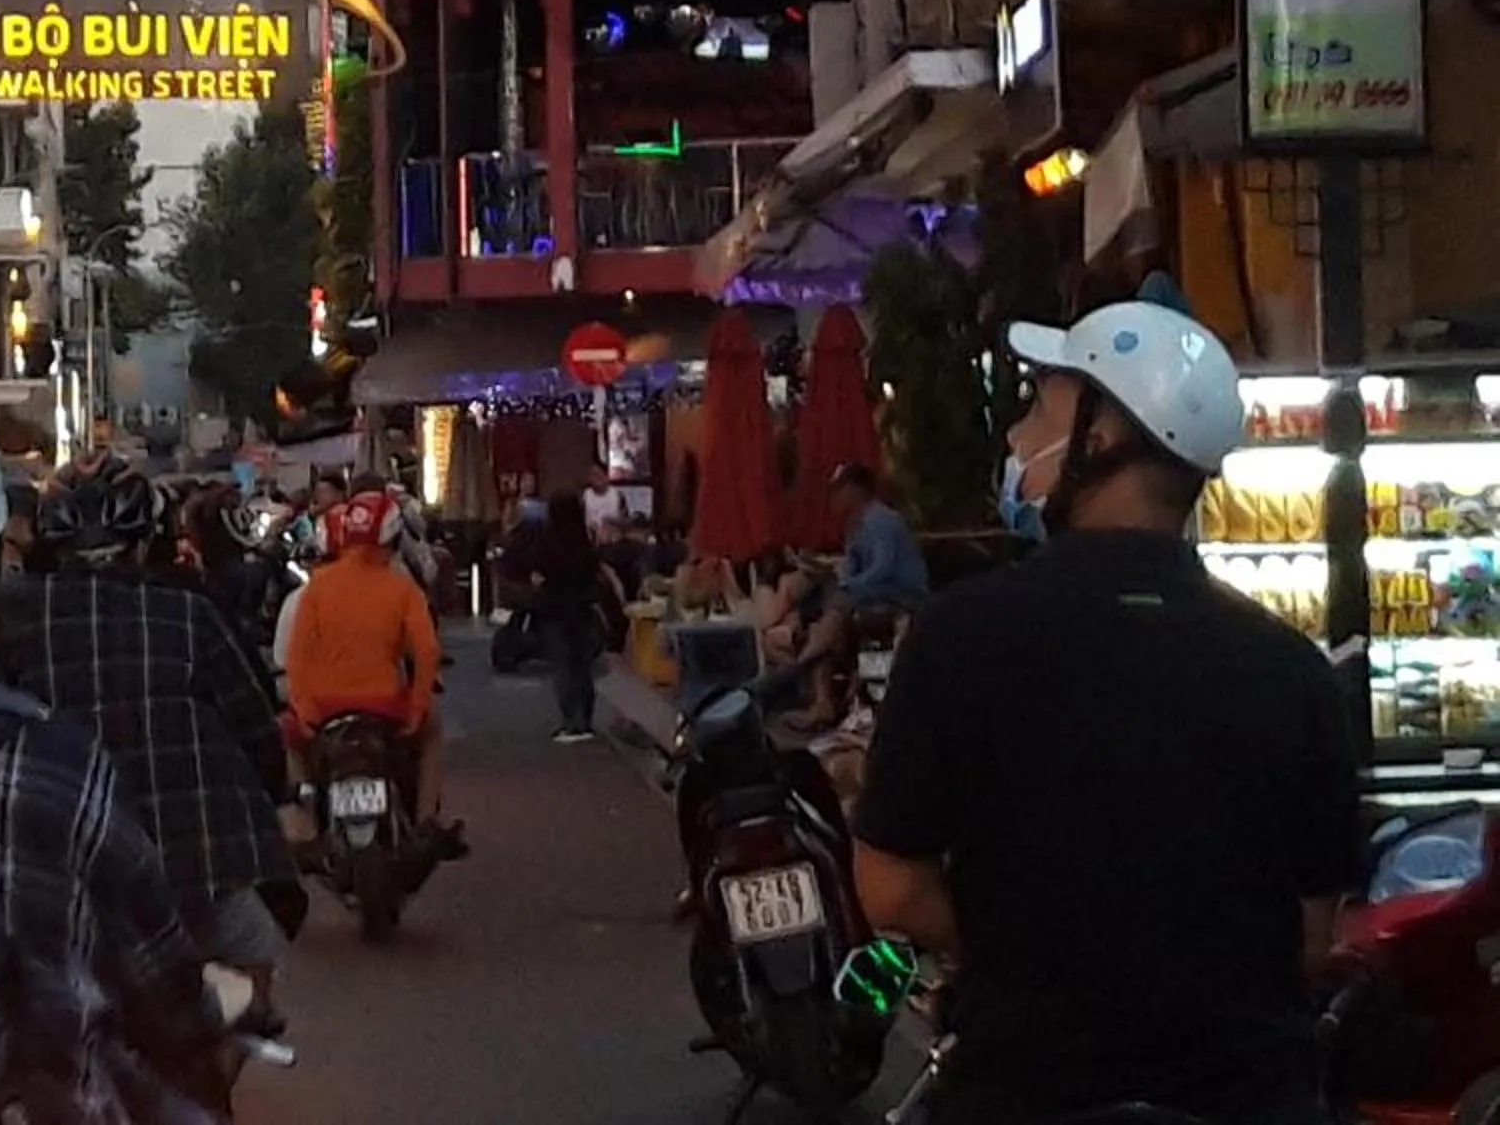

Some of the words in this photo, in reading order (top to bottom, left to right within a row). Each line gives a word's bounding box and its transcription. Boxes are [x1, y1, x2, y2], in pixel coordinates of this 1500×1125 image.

[2, 2, 71, 69] BỘ
[83, 0, 167, 56] BÙI
[180, 2, 290, 68] VIỆN
[152, 69, 277, 100] STREET
